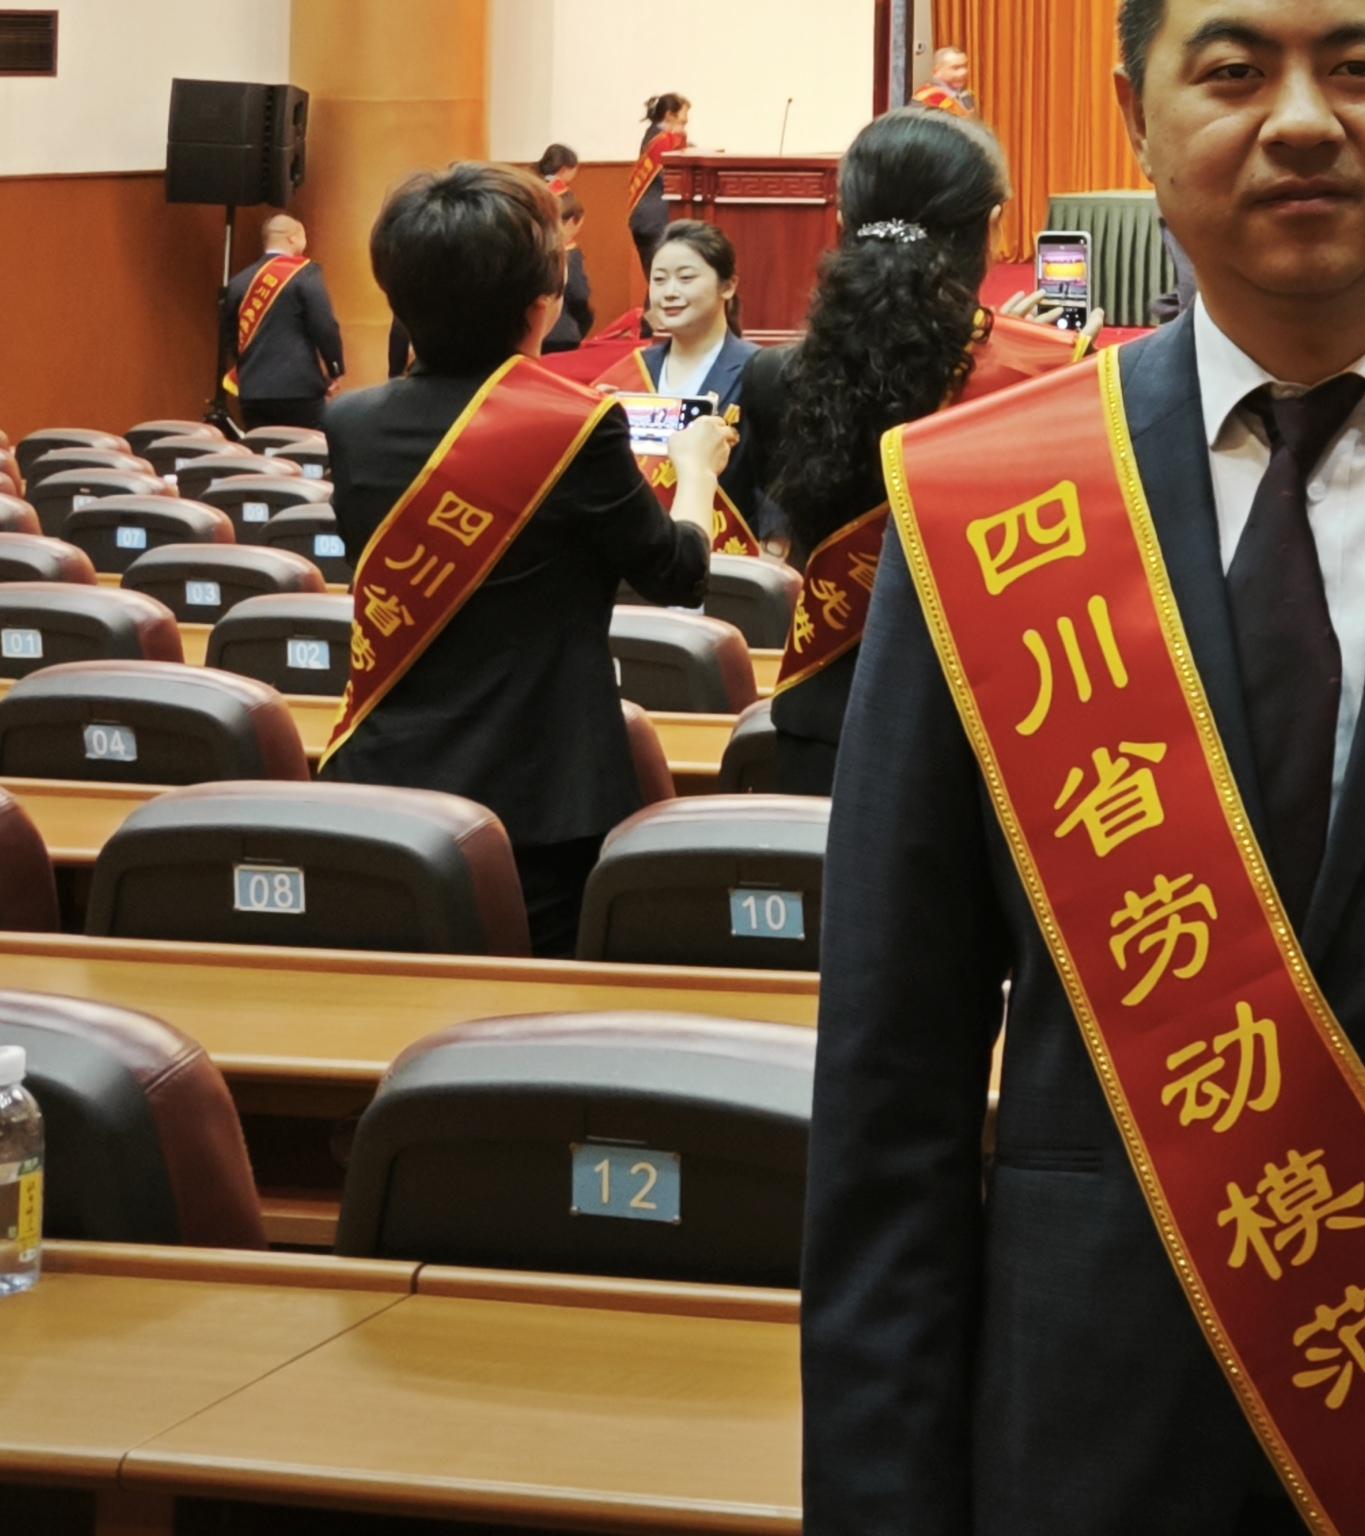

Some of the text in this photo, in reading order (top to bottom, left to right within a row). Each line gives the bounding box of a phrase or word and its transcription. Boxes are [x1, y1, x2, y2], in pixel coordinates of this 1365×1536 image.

[123, 530, 141, 546] 07
[191, 583, 216, 603] 03
[338, 490, 494, 724] 四川省劳
[10, 633, 34, 654] 01
[296, 643, 321, 664] 02
[92, 730, 126, 756] 04
[249, 874, 294, 909] 08
[741, 894, 786, 931] 10
[594, 1159, 658, 1210] 12
